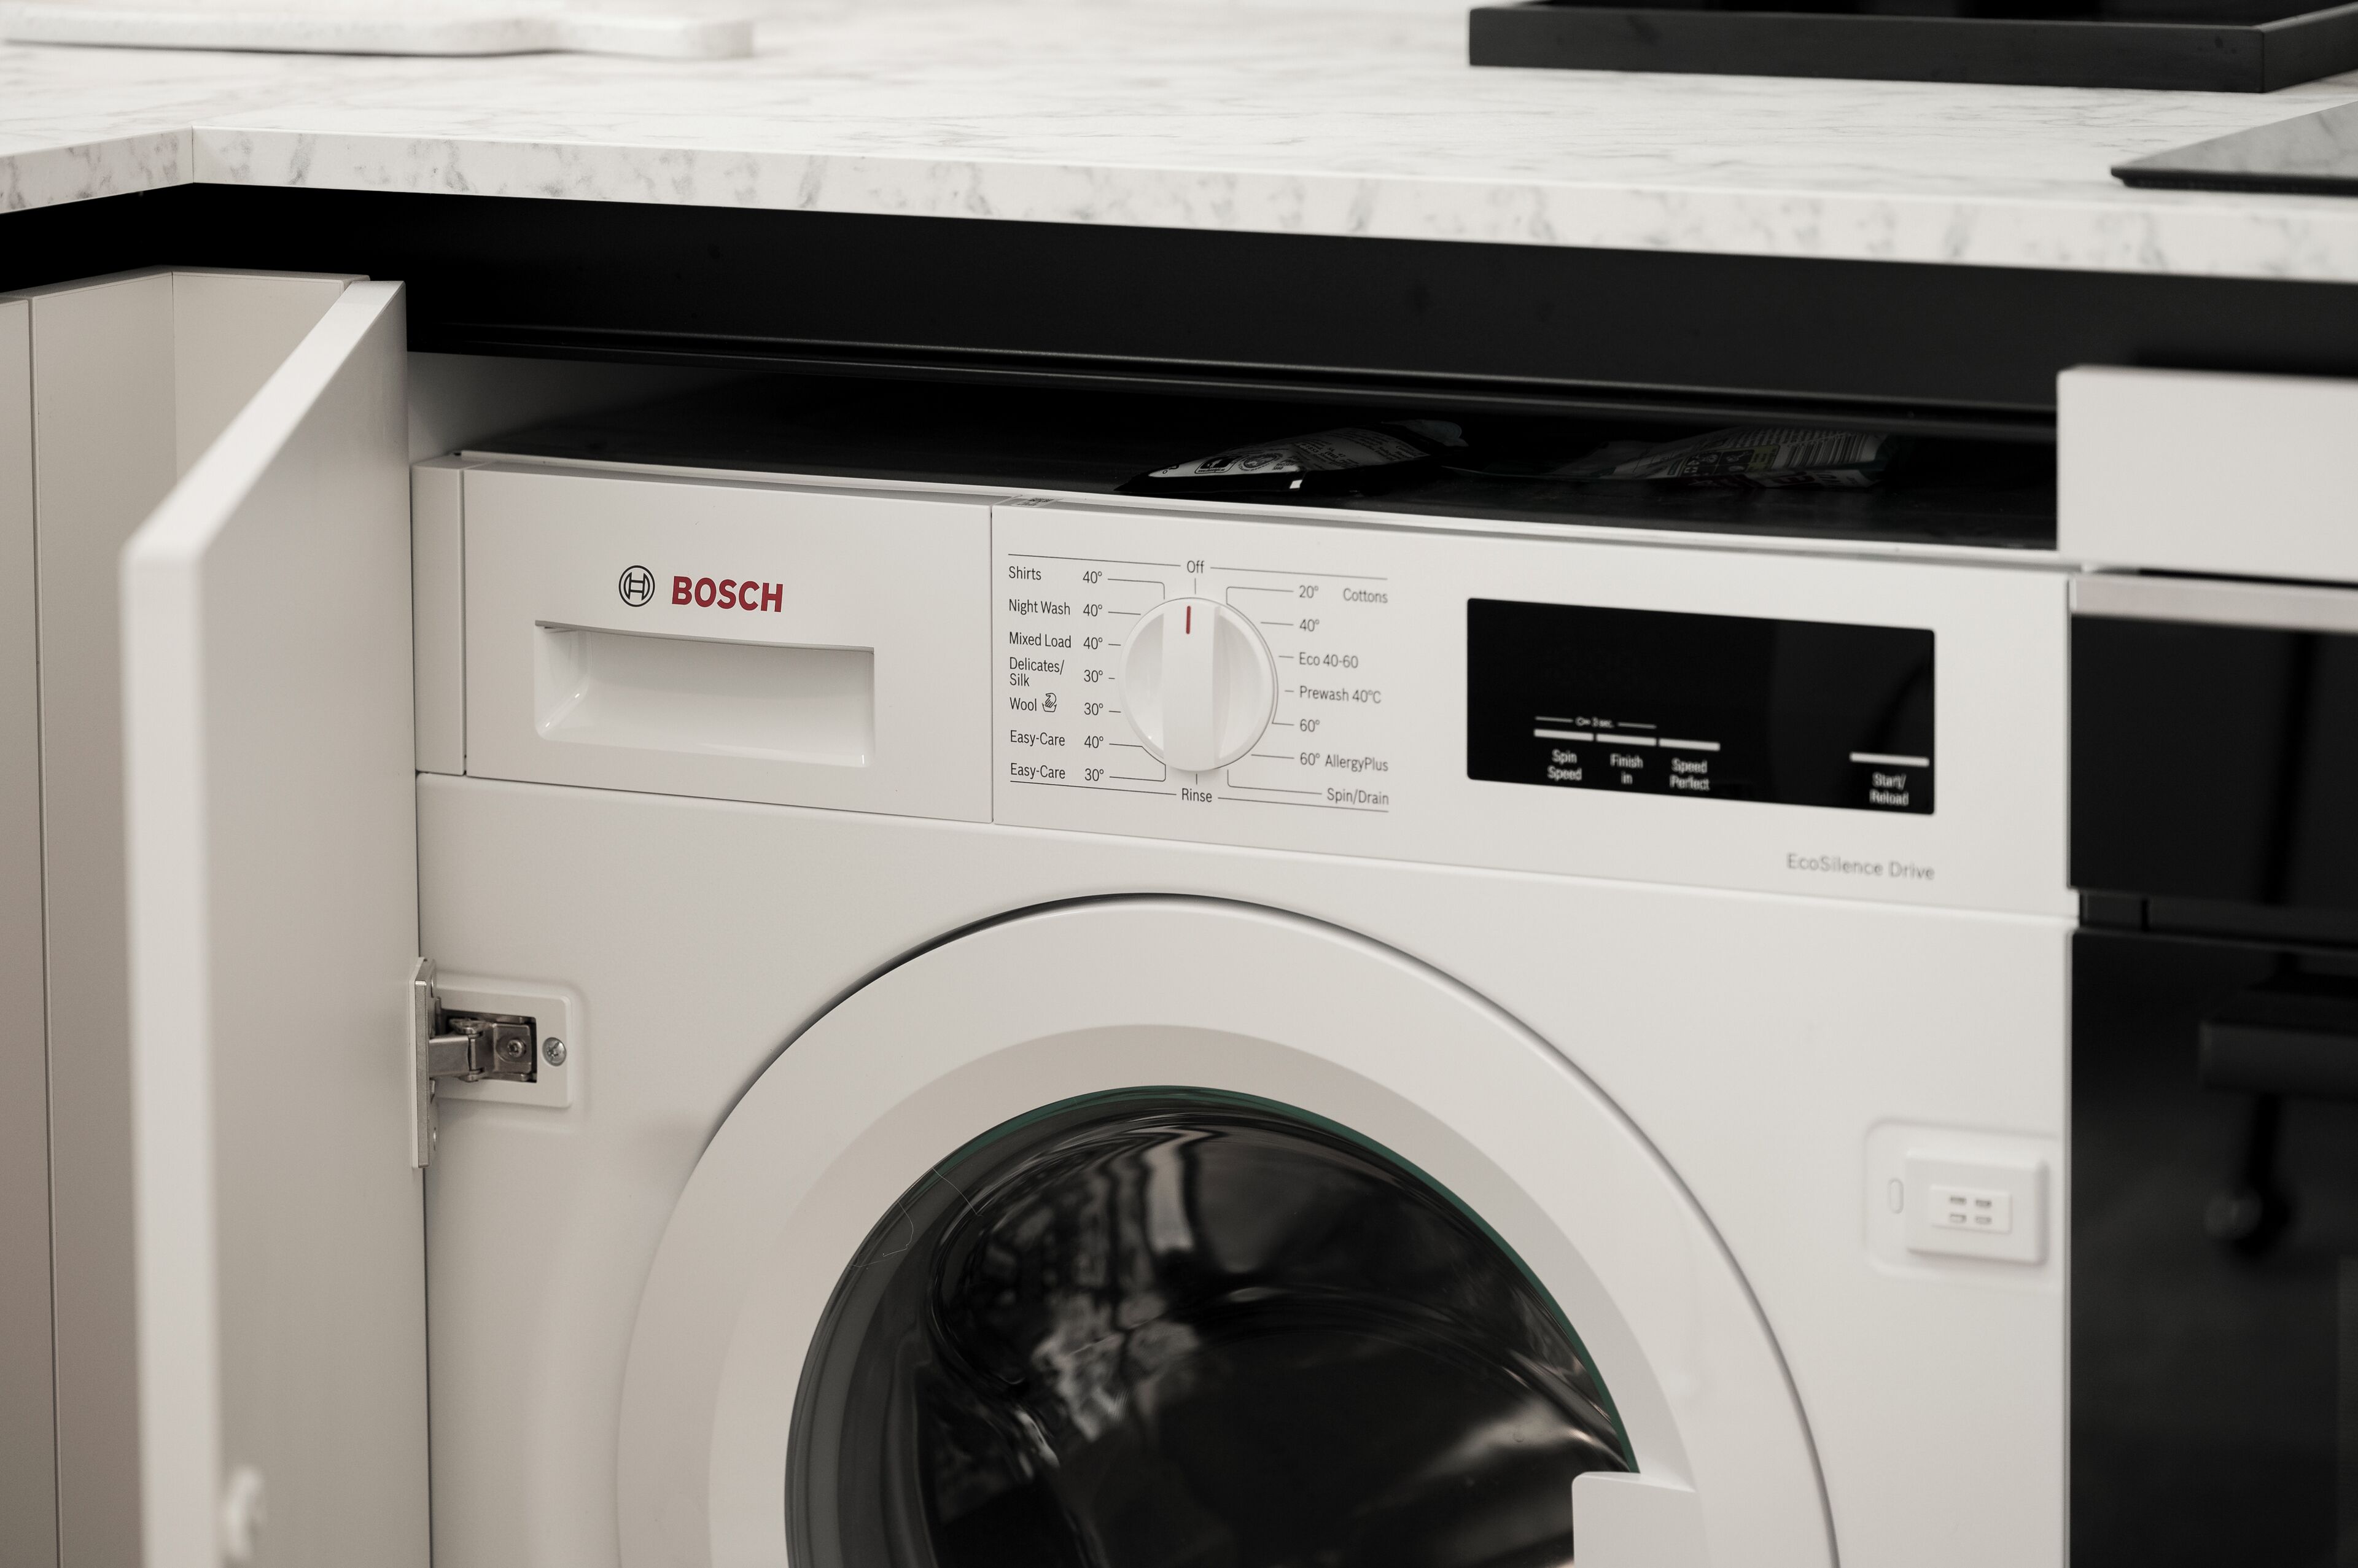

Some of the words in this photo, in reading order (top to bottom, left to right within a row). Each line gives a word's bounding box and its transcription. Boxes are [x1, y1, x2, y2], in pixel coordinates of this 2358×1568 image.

[1008, 565, 1041, 581] Shirts
[1083, 570, 1103, 584] 40°
[1186, 560, 1205, 574] Off
[671, 575, 784, 613] BOSCH
[1299, 584, 1319, 599] 20°
[1342, 588, 1388, 604] Cottons
[1009, 599, 1038, 616] Night
[1040, 600, 1070, 616] Wash
[1083, 604, 1103, 617] 40°
[1299, 618, 1320, 632] 40°
[1009, 631, 1041, 646] Mixed
[1045, 634, 1072, 648] Load
[1083, 636, 1103, 650] 40°
[1010, 656, 1065, 675] Delicates/
[1299, 651, 1320, 666] Eco
[1323, 653, 1359, 669] 40-60
[1010, 672, 1030, 687] Silk
[1083, 669, 1103, 683] 30°
[1299, 685, 1349, 701] Prewash
[1352, 689, 1381, 704] 40°C
[1009, 697, 1037, 712] Wool
[1084, 702, 1103, 716] 30°
[1299, 718, 1320, 732] 60°
[1010, 729, 1065, 747] Easy-Care
[1084, 735, 1104, 749] 40°
[1299, 751, 1321, 766] 60°
[1325, 754, 1389, 773] AllergyPlus
[1552, 749, 1578, 765] Spin
[1609, 753, 1644, 769] Finish
[1010, 762, 1065, 780] Easy-Care
[1084, 767, 1104, 782] 30°
[1547, 765, 1582, 782] Speed
[1671, 758, 1708, 774] Speed
[1621, 772, 1633, 784] in
[1669, 774, 1710, 791] Perfect
[1872, 772, 1907, 790] Start/
[1181, 788, 1212, 803] Rinse
[1326, 787, 1389, 805] Spin/Drain
[1869, 789, 1909, 806] Reload
[1786, 852, 1884, 877] EcoSilence
[1888, 861, 1936, 880] Drive
